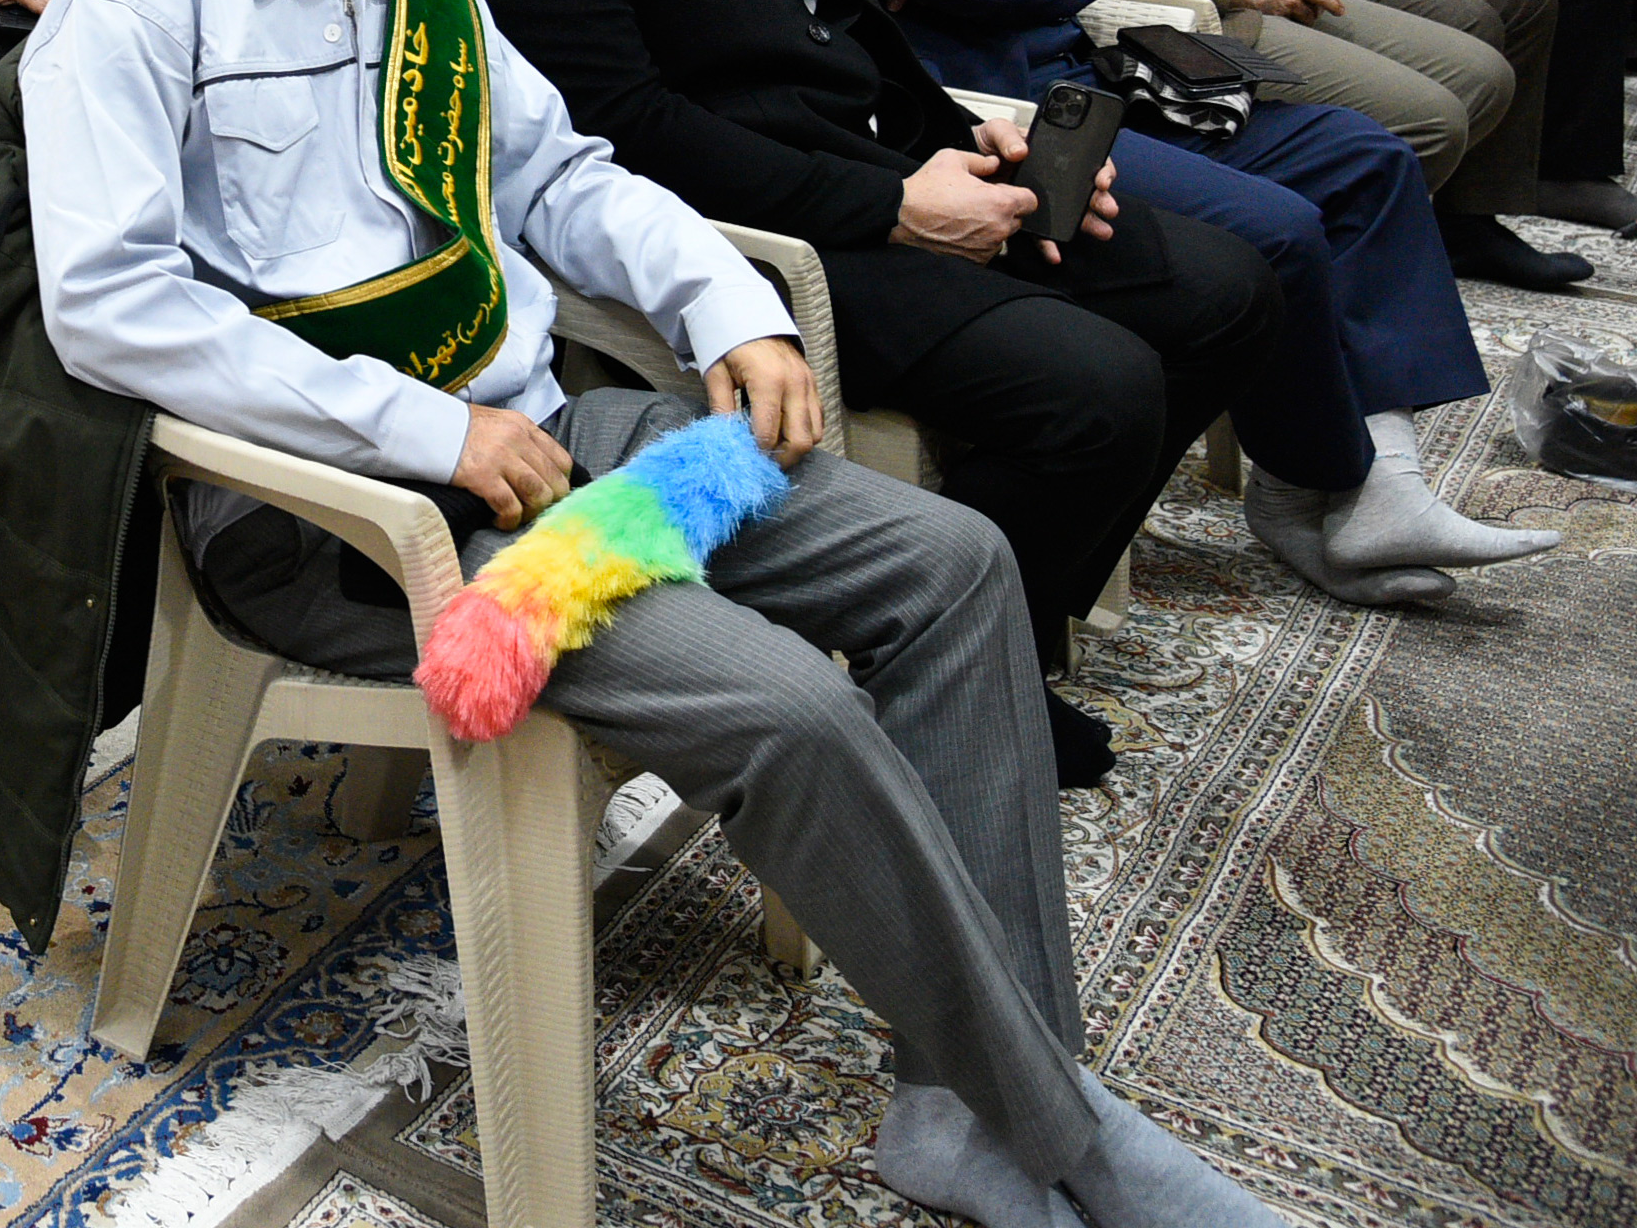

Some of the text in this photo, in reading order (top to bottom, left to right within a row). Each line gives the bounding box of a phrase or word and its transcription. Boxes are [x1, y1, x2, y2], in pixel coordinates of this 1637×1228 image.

[399, 22, 429, 165] خادمین
[449, 37, 474, 89] سپاه
[437, 89, 464, 166] حضرت
[442, 172, 461, 227] محم
